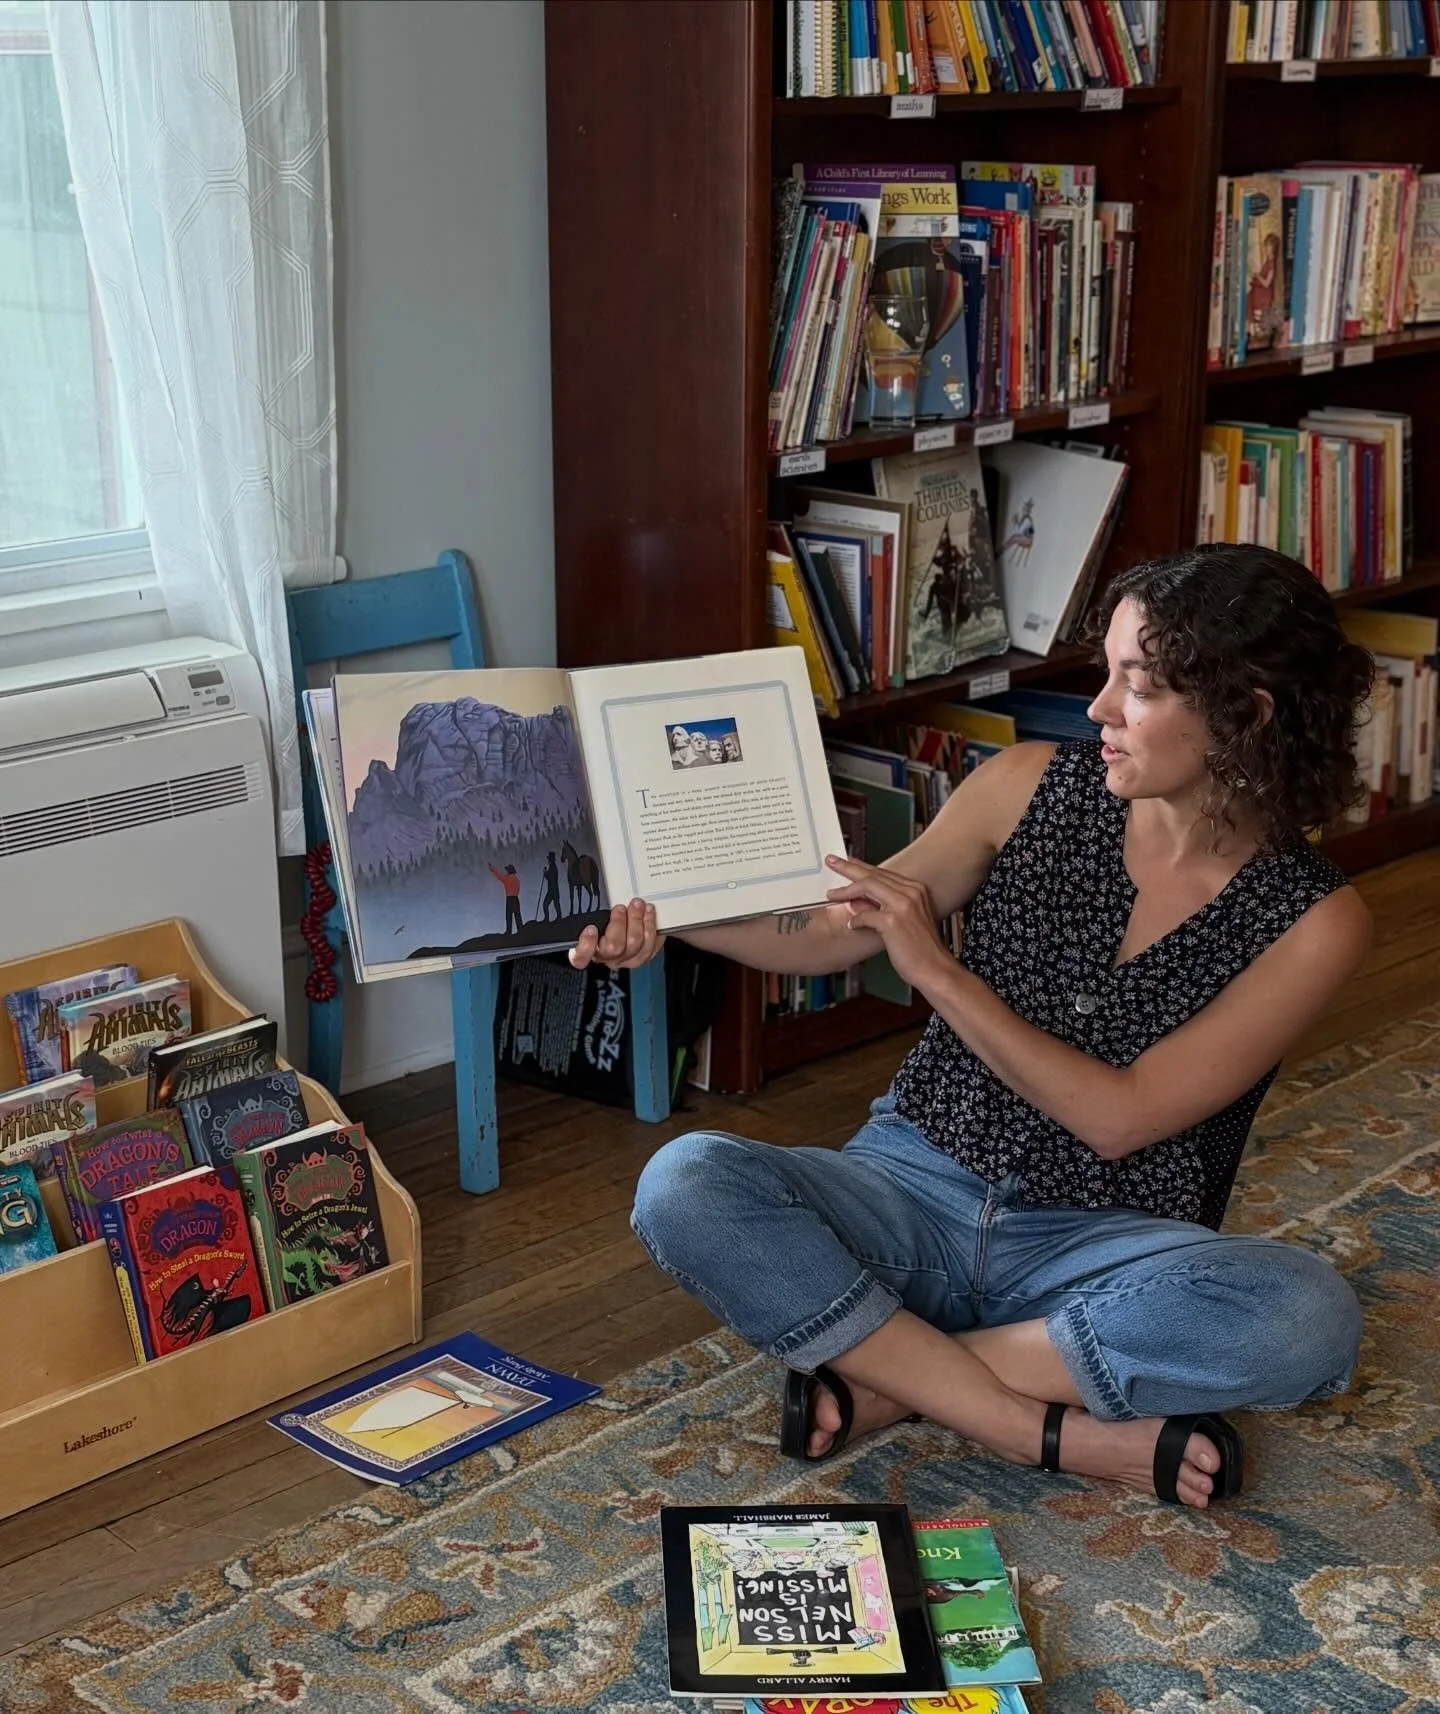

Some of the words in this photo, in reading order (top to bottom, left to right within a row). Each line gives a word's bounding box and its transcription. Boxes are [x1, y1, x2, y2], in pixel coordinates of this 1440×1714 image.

[815, 167, 823, 178] A
[823, 167, 851, 179] Child's
[852, 167, 871, 178] First
[871, 167, 901, 180] Library
[901, 167, 910, 178] of
[911, 167, 948, 180] Learning
[910, 187, 952, 205] Work
[913, 480, 968, 507] THIRTEEN
[917, 498, 971, 523] COLONIES
[112, 1042, 141, 1056] BLOOD
[226, 1040, 258, 1054] BEASTS
[0, 1091, 86, 1152] NIMALS
[9, 1144, 38, 1159] BLOOD
[80, 1141, 180, 1191] DRAGON'S
[108, 1165, 160, 1195] TALE
[281, 1225, 295, 1239] How
[294, 1219, 302, 1228] to
[301, 1210, 318, 1222] Seize
[324, 1203, 350, 1214] Dragon's
[160, 1219, 218, 1253] DRAGON
[148, 1278, 164, 1292] How
[162, 1270, 171, 1279] to
[170, 1260, 189, 1275] Steal
[194, 1251, 223, 1264] Dragon's
[223, 1249, 246, 1261] Sword
[484, 1363, 537, 1387] DAWN
[732, 1513, 793, 1521] MARSHALL
[795, 1512, 830, 1520] JAMES
[739, 1602, 853, 1624] NELSON
[809, 1676, 851, 1684] HARRY
[927, 1692, 979, 1712] The
